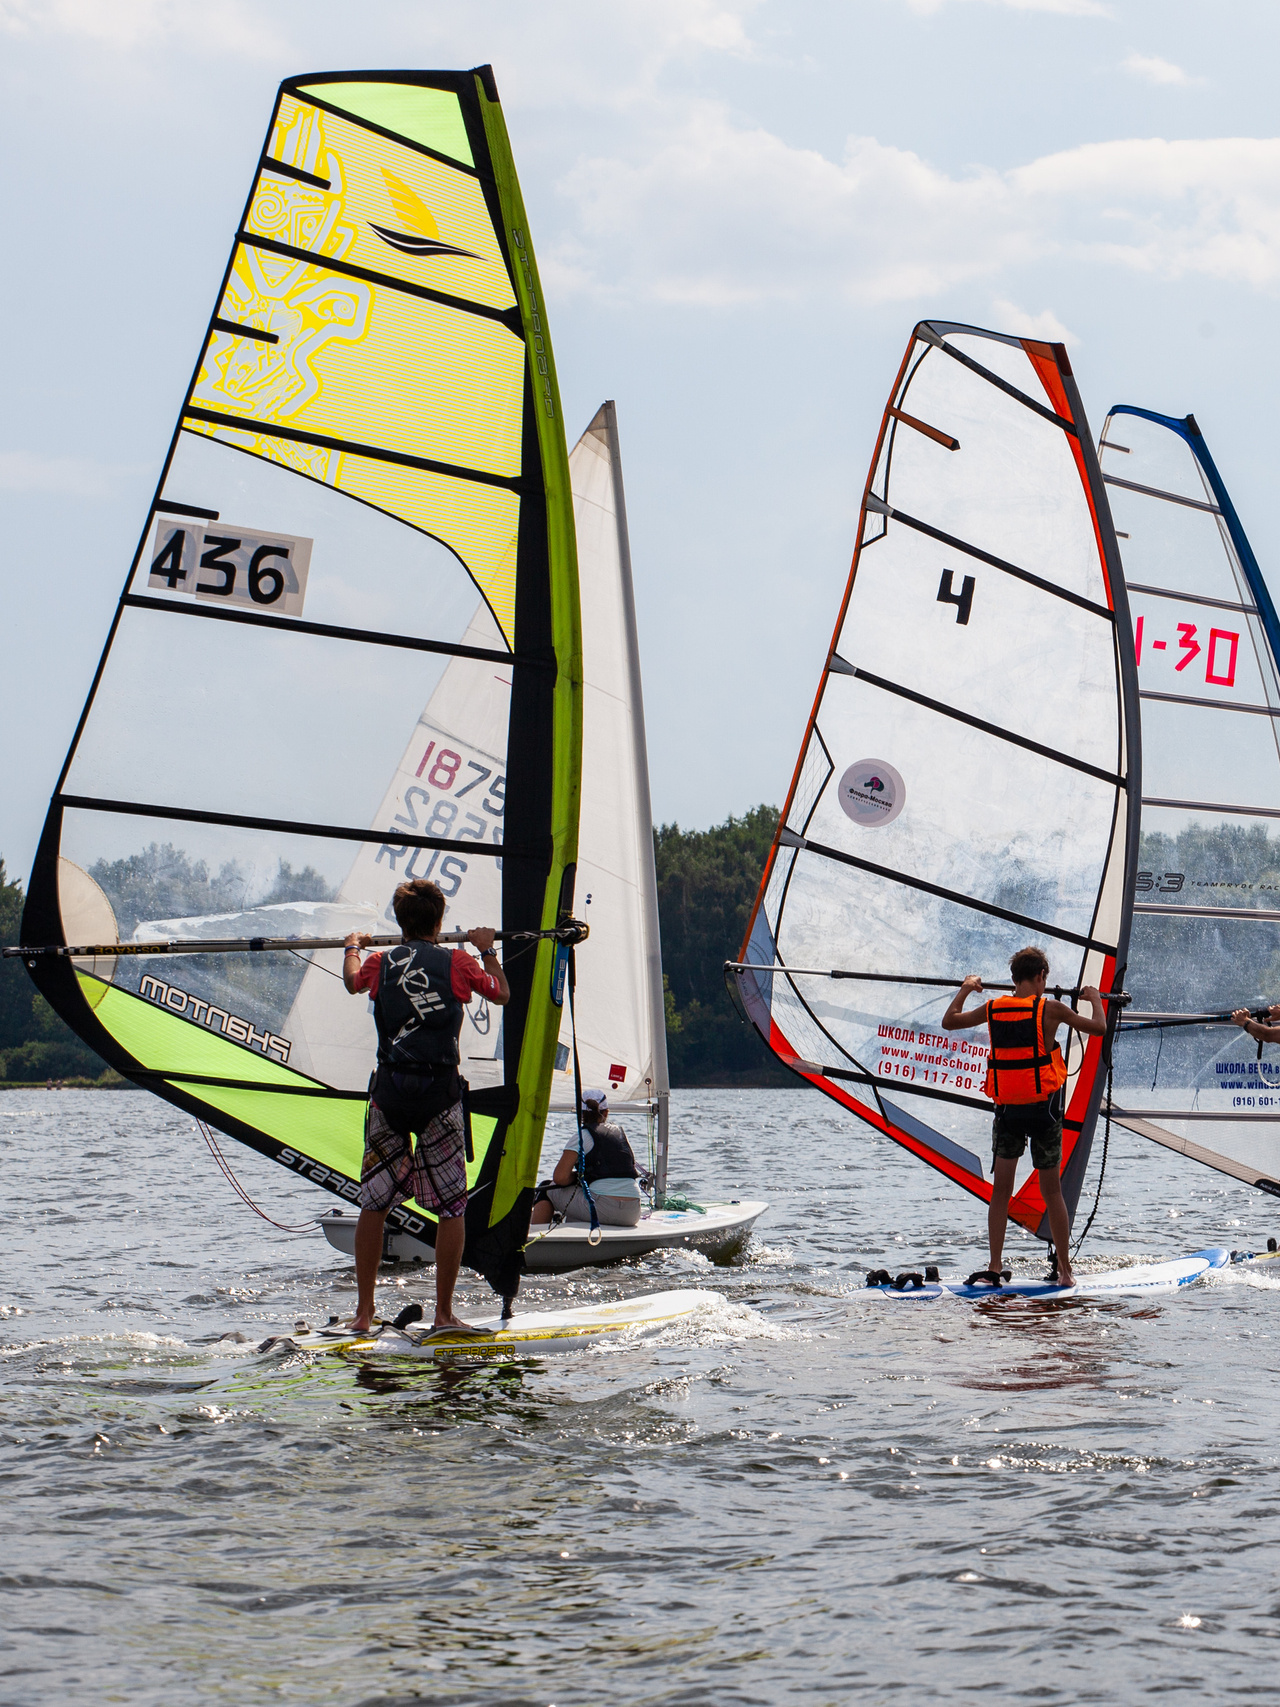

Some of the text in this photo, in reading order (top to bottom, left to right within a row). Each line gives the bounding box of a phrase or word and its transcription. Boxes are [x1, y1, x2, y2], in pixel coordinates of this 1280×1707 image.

[150, 529, 290, 605] 436
[936, 568, 976, 626] 4
[375, 826, 469, 898] RUS
[1191, 880, 1254, 890] TEAMPRYDE
[878, 1024, 990, 1059] ШКОЛА ВЕТРА в Строг
[878, 1060, 916, 1081] (916)
[881, 1045, 989, 1075] www.windschool.
[1216, 1062, 1246, 1075] ШКОЛА
[1232, 1096, 1256, 1108] (916)
[276, 1147, 426, 1235] STARBRD
